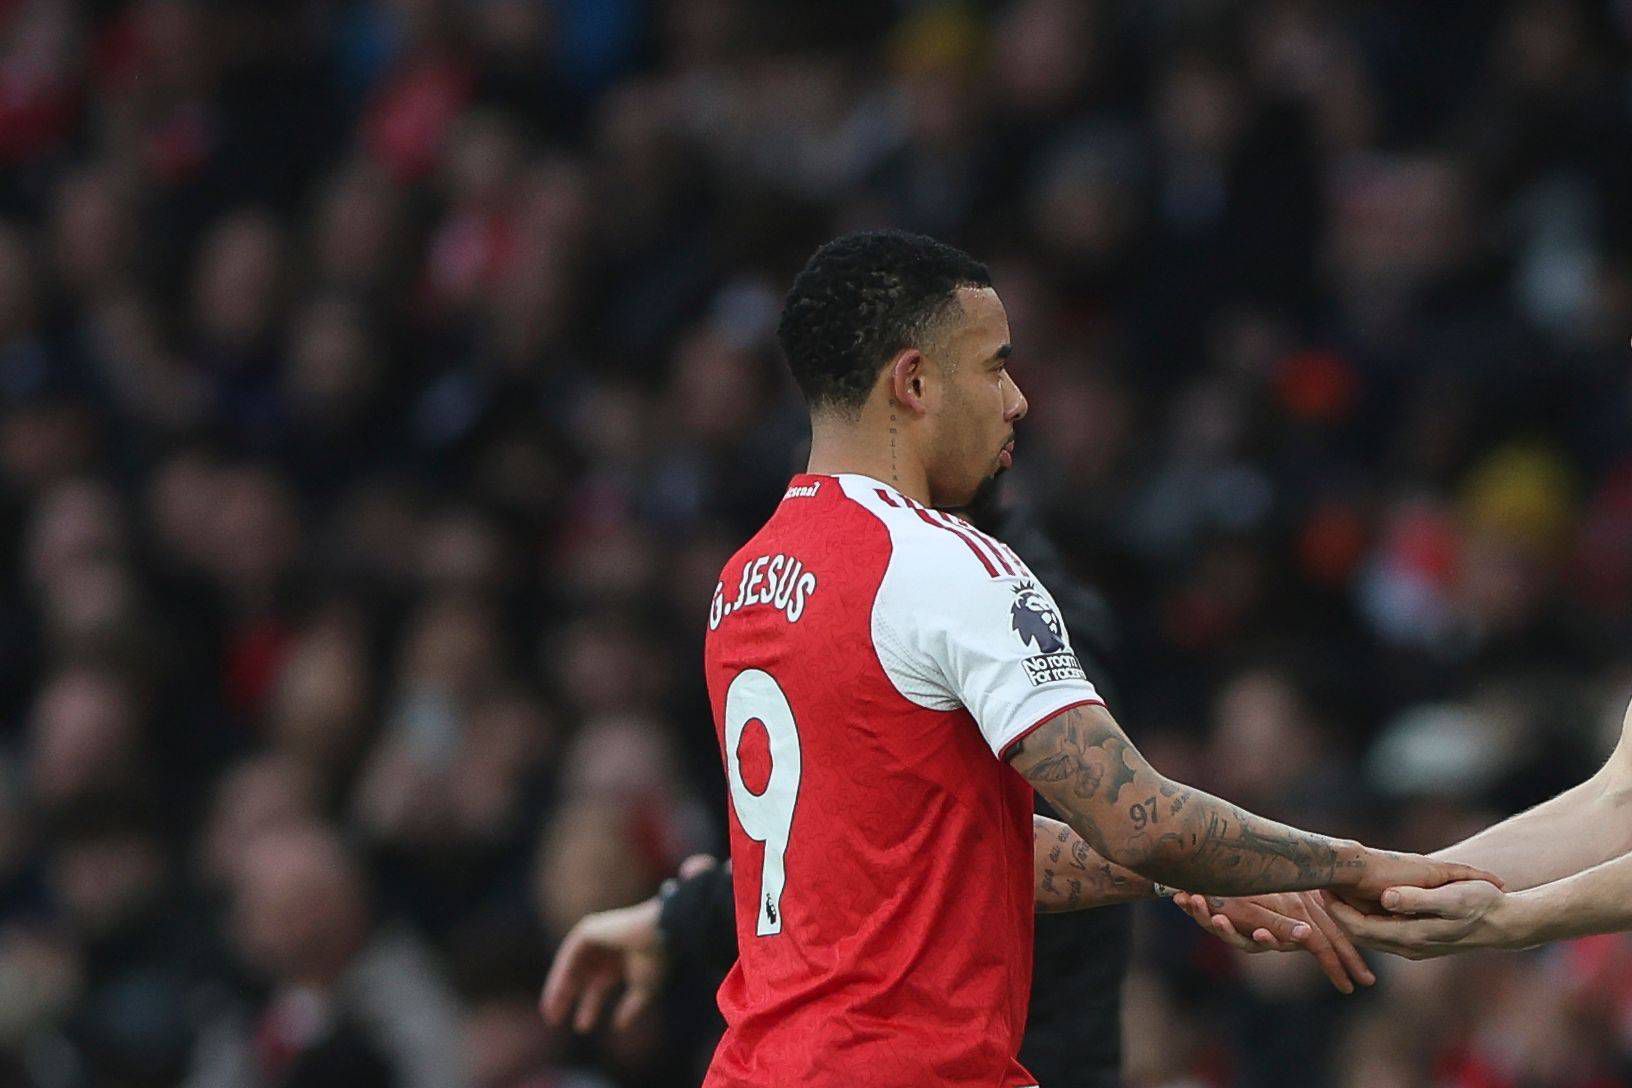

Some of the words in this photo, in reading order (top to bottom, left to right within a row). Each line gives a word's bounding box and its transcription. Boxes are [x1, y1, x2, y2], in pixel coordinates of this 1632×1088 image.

[1022, 657, 1048, 672] No
[1046, 655, 1078, 669] room
[725, 667, 802, 936] 9
